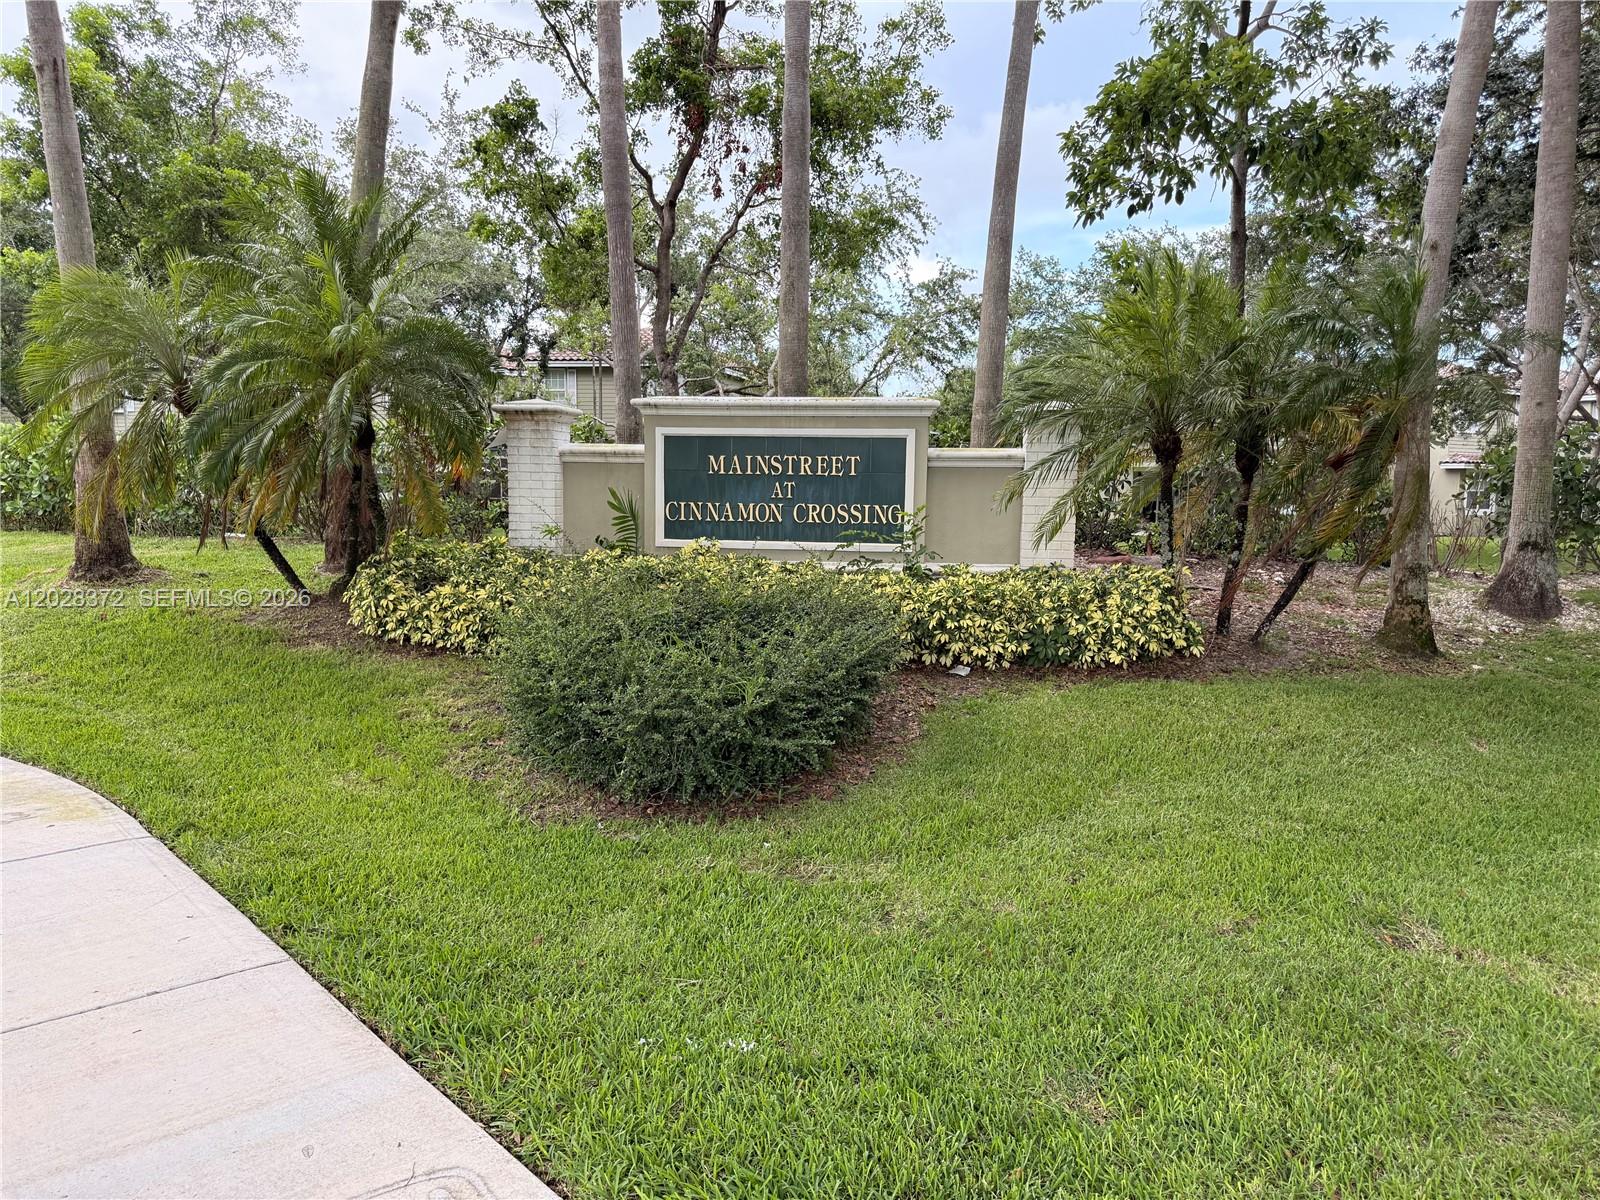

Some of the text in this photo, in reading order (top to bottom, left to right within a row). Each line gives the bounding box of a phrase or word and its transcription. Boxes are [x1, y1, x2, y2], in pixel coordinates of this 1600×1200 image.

[707, 455, 860, 476] MAINSTREET
[771, 481, 796, 499] AT
[665, 501, 902, 525] CINNAMON CROSSING
